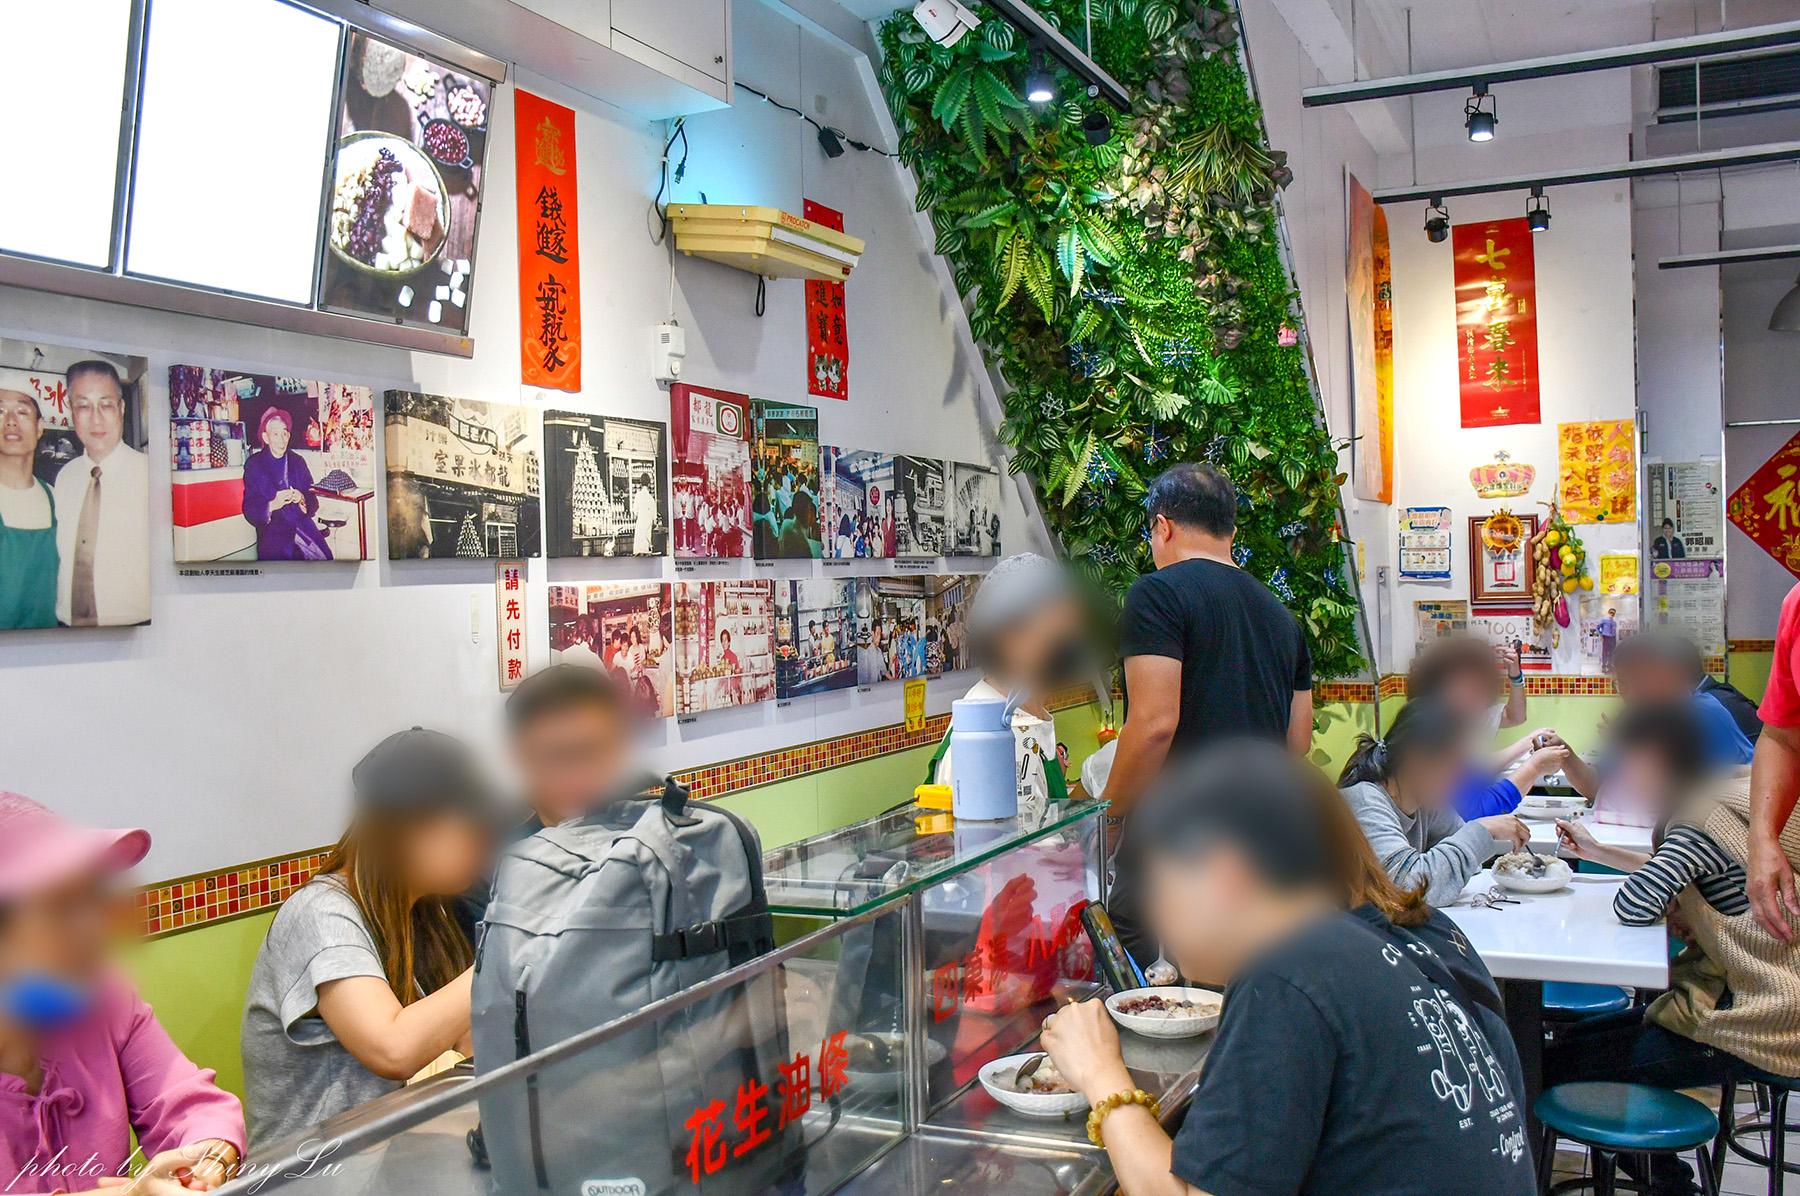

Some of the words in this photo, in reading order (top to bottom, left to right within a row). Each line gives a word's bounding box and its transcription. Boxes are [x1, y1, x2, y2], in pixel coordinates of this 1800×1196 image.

[504, 569, 522, 680] 請先付款
[685, 1029, 849, 1185] 花生油條
[1459, 1117, 1474, 1129] EST.
[587, 1184, 641, 1196] OUTDOOR
